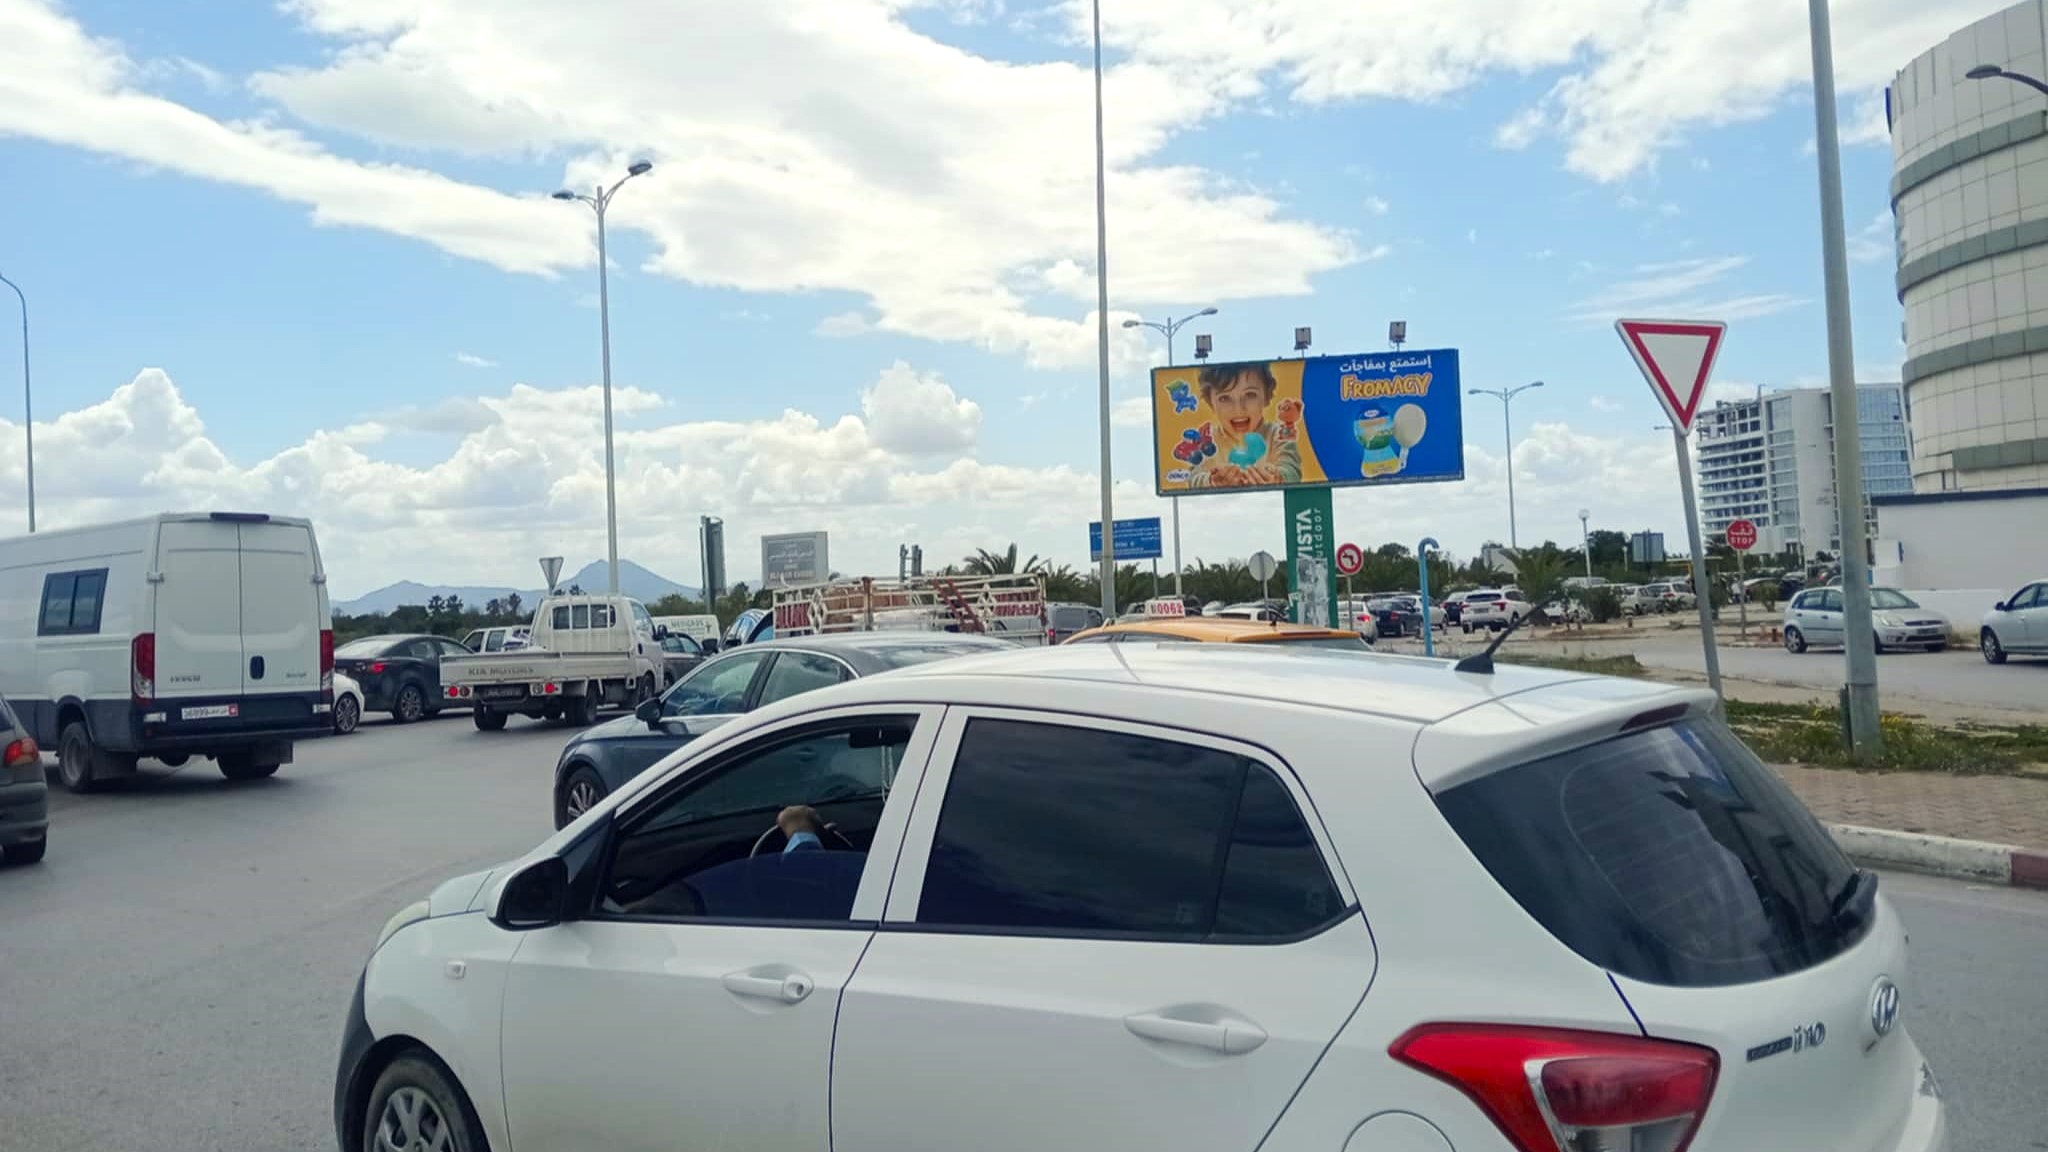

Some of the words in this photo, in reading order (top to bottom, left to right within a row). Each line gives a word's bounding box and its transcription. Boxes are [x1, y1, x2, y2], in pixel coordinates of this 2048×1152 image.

[1340, 372, 1433, 401] FROMAGY
[1731, 536, 1754, 545] STOP
[468, 667, 487, 676] KIA
[1793, 1022, 1825, 1053] i10
